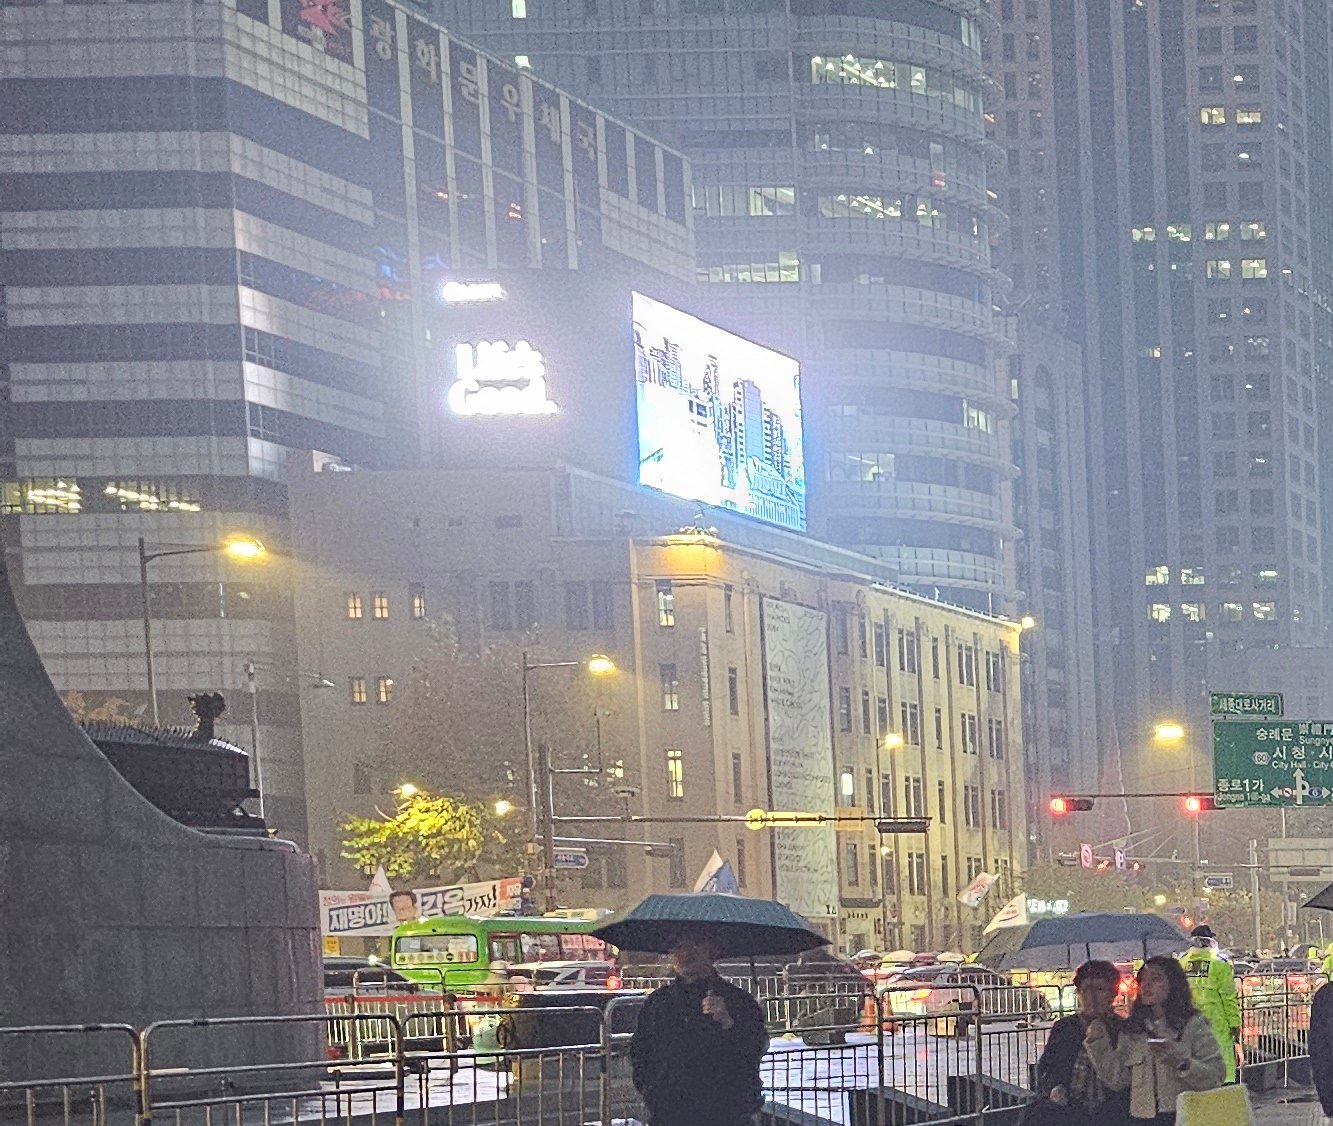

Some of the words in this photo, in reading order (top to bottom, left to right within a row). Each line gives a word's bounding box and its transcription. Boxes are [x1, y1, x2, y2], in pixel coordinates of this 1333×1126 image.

[369, 14, 597, 162] 광화문우체국
[1219, 697, 1276, 713] 세종대로사거리
[1256, 753, 1267, 762] 60
[1271, 761, 1288, 771] City
[1290, 760, 1306, 769] Hall
[1313, 761, 1329, 771] City
[329, 902, 388, 931] 재명아!
[466, 884, 497, 913] 가자!
